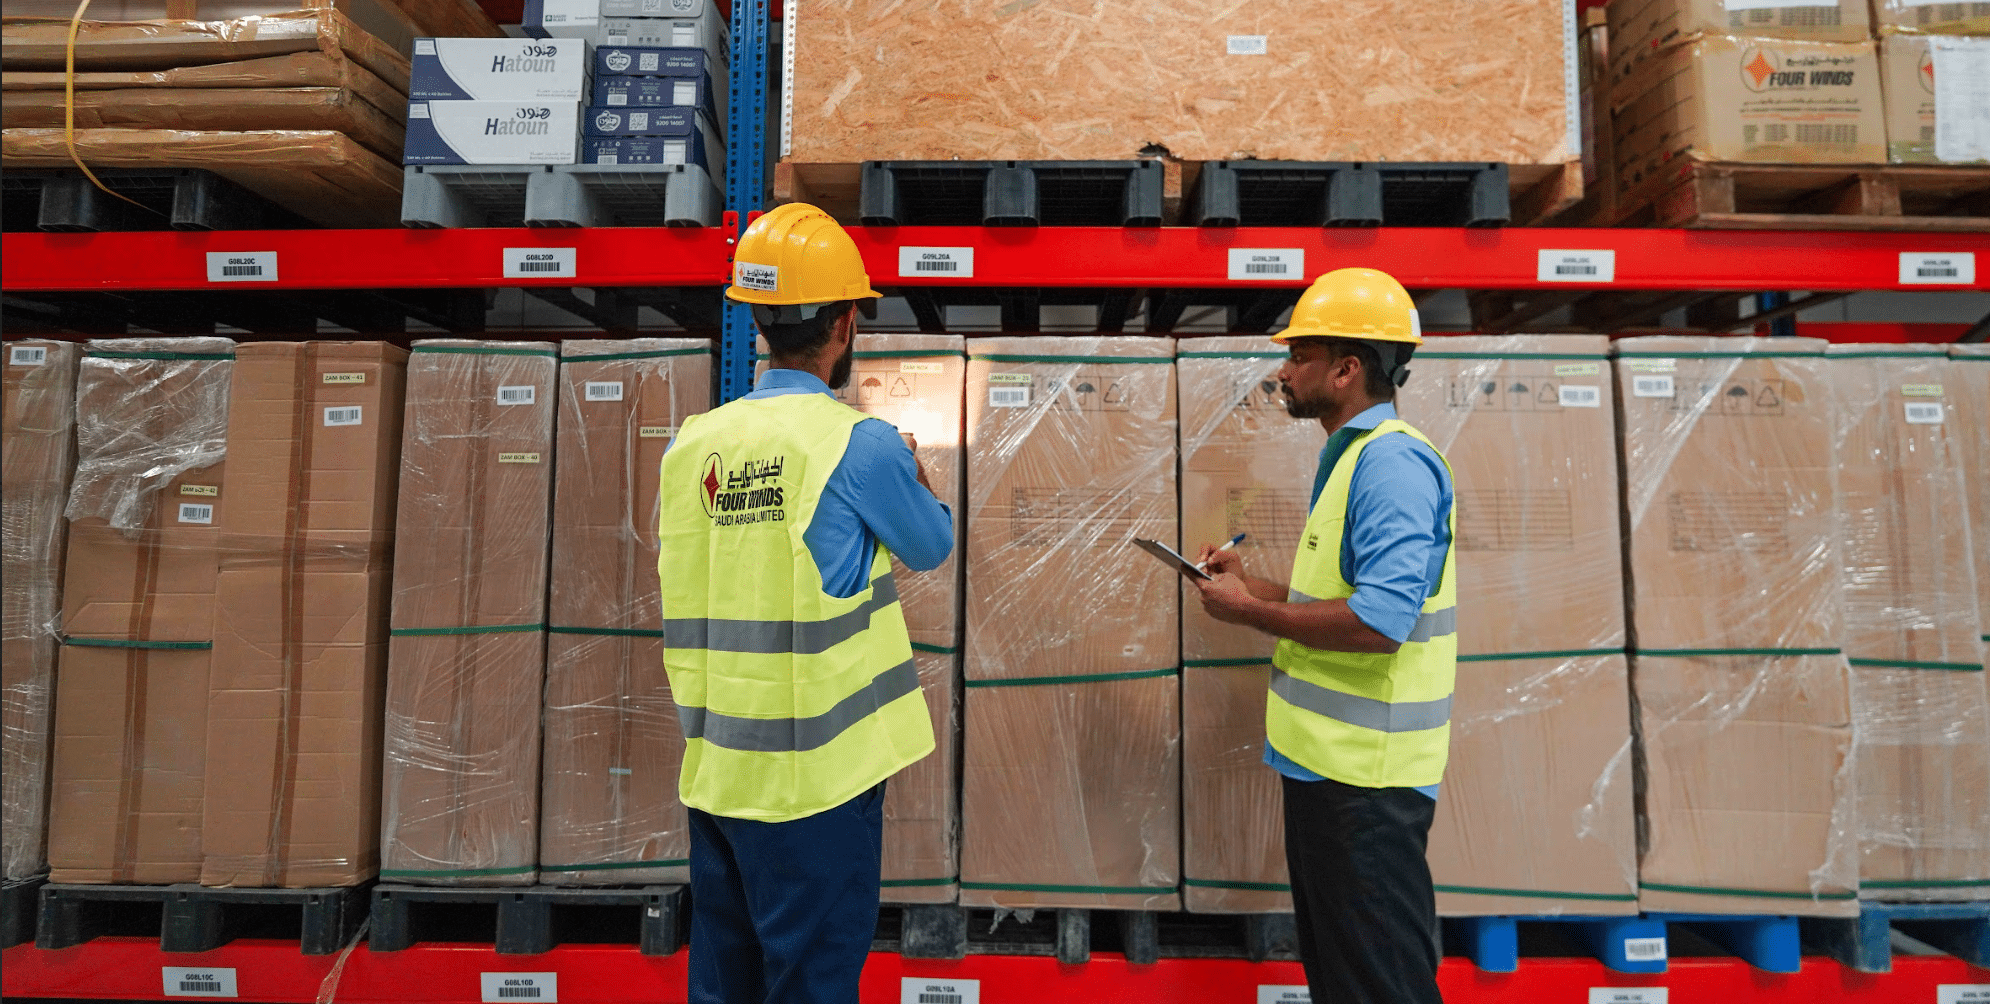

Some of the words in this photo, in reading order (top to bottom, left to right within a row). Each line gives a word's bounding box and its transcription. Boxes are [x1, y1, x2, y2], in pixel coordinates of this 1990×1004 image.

[491, 54, 556, 73] Hatoun
[1769, 71, 1805, 86] FOUR
[1809, 71, 1854, 86] WINDS
[484, 117, 549, 135] Hatoun
[756, 278, 775, 286] WINDS
[715, 492, 748, 512] FOUR
[748, 487, 784, 509] WINDS
[714, 514, 734, 527] SAUDI
[734, 512, 756, 525] ARABIA
[756, 509, 785, 523] LIMITED
